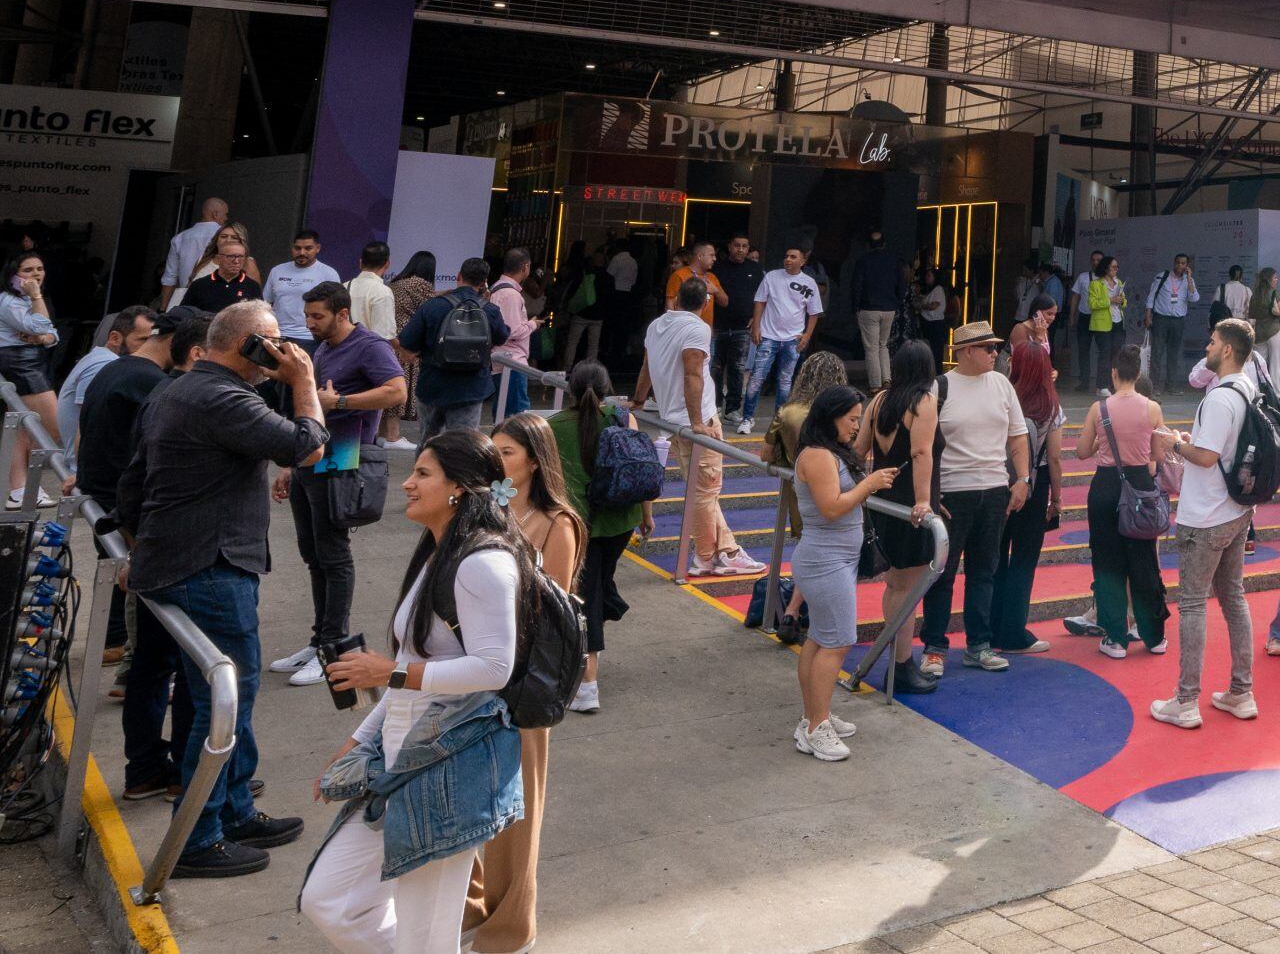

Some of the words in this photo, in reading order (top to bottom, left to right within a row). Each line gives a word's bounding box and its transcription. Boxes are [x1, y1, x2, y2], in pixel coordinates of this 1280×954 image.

[0, 106, 70, 131] nto
[83, 109, 156, 136] flex
[659, 112, 849, 159] PROTELA
[6, 134, 97, 148] TEXTILES
